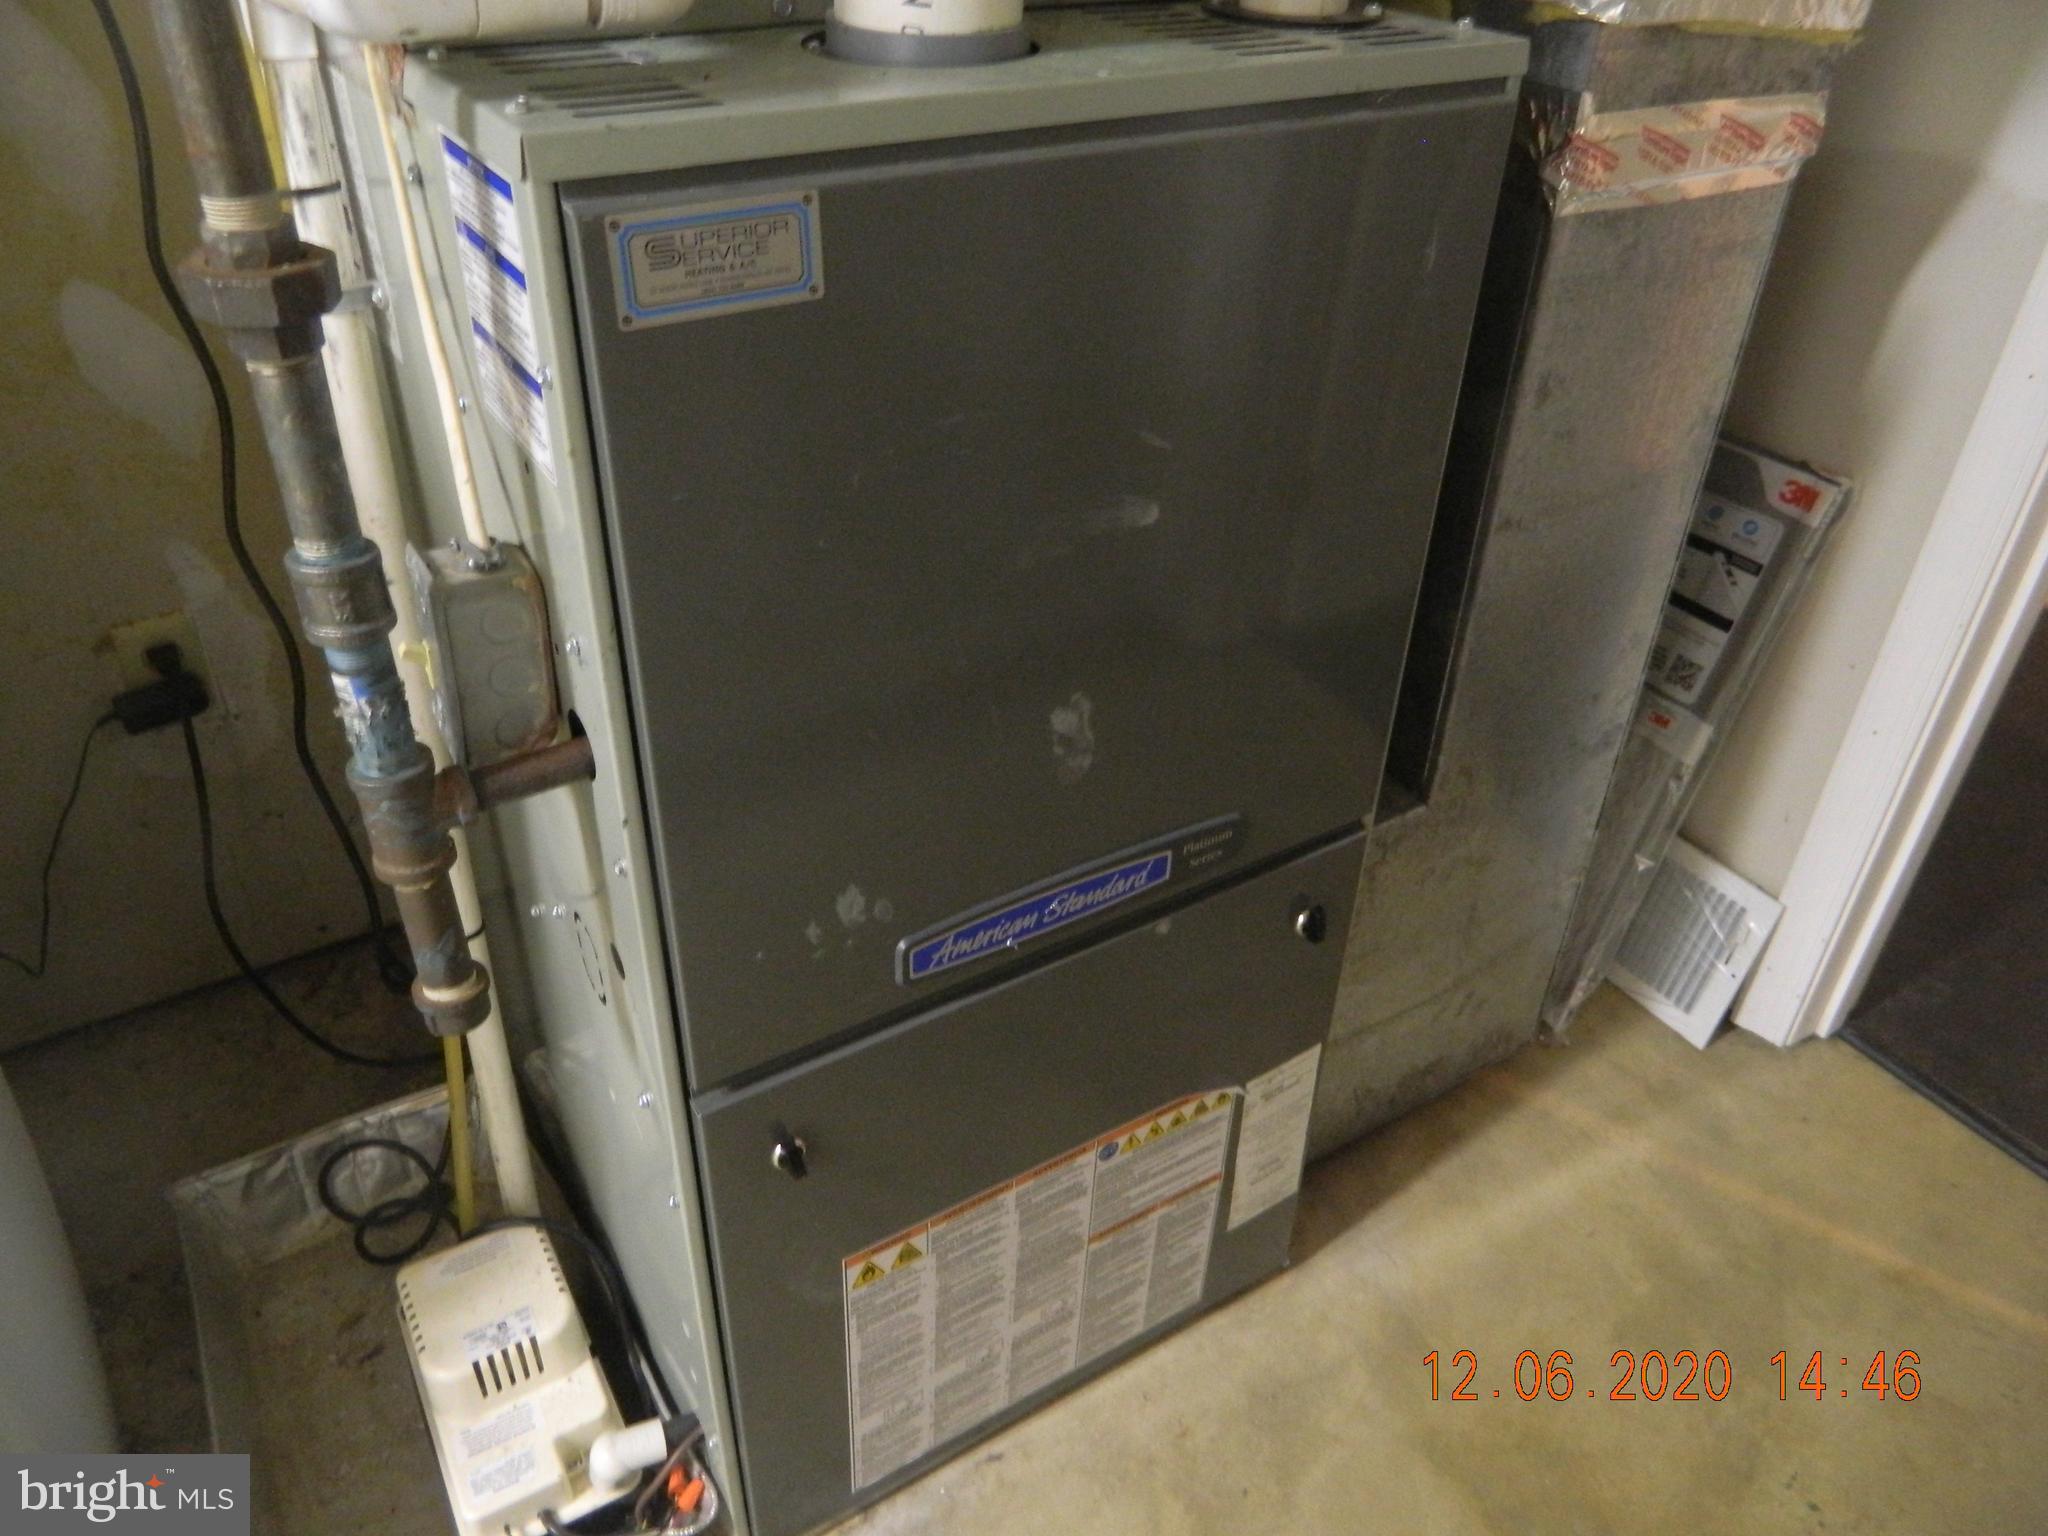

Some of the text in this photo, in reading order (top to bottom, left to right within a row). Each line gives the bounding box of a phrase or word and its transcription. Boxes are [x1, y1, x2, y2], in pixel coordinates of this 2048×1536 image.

[1777, 479, 1823, 514] 3M
[1648, 711, 1673, 730] 3M
[929, 860, 1155, 969] American Standard
